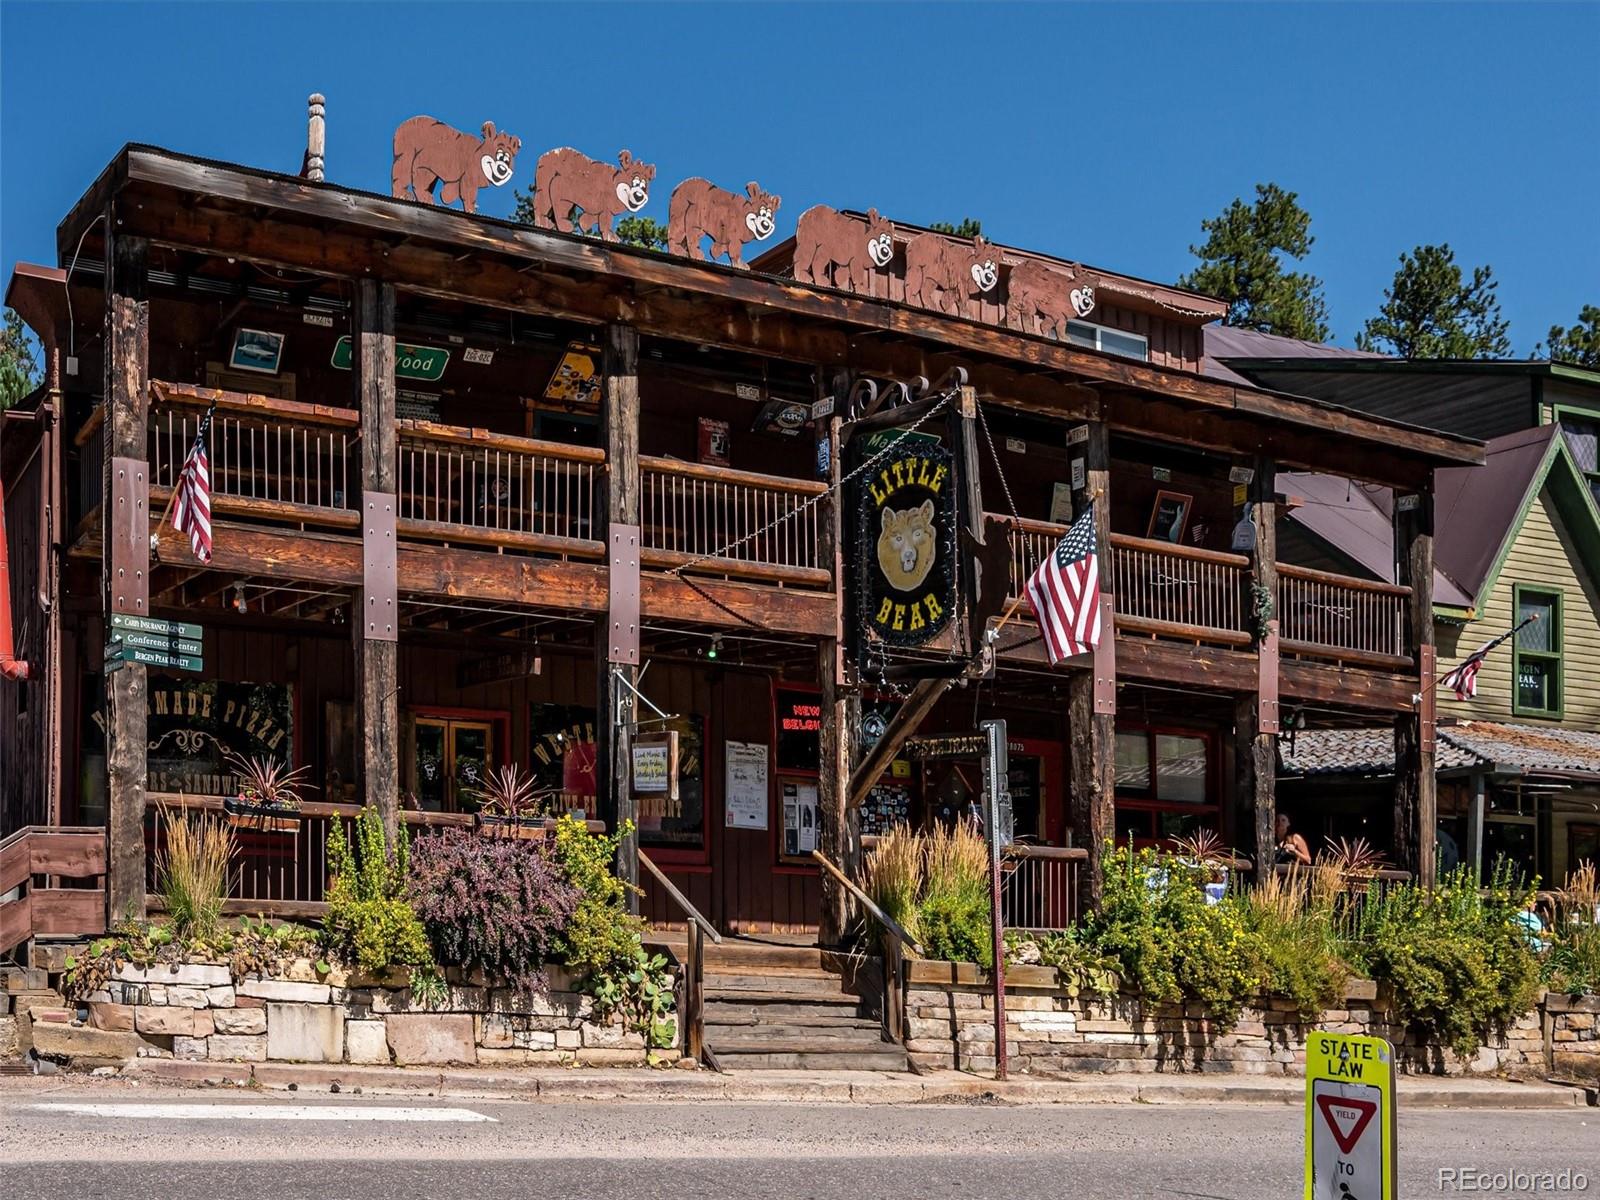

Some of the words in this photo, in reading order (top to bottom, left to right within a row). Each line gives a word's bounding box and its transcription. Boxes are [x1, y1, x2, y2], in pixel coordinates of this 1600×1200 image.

[869, 457, 948, 506] LITTLE
[876, 593, 943, 631] BEAR
[127, 634, 170, 648] Conference
[171, 640, 198, 652] Center
[135, 651, 155, 661] BERGEN
[155, 654, 169, 664] PEAK
[169, 656, 190, 667] REALTY
[793, 705, 820, 717] NEW
[224, 700, 285, 749] PIZZA
[783, 718, 820, 730] BELGI
[533, 722, 594, 766] WESTE
[905, 735, 986, 758] RESTAURANT
[185, 774, 244, 796] SANDWI
[551, 794, 579, 812] LIVE
[1320, 1039, 1373, 1060] STATE
[1328, 1059, 1364, 1079] LAW
[1336, 1109, 1356, 1120] YIELD
[1338, 1160, 1355, 1176] TO
